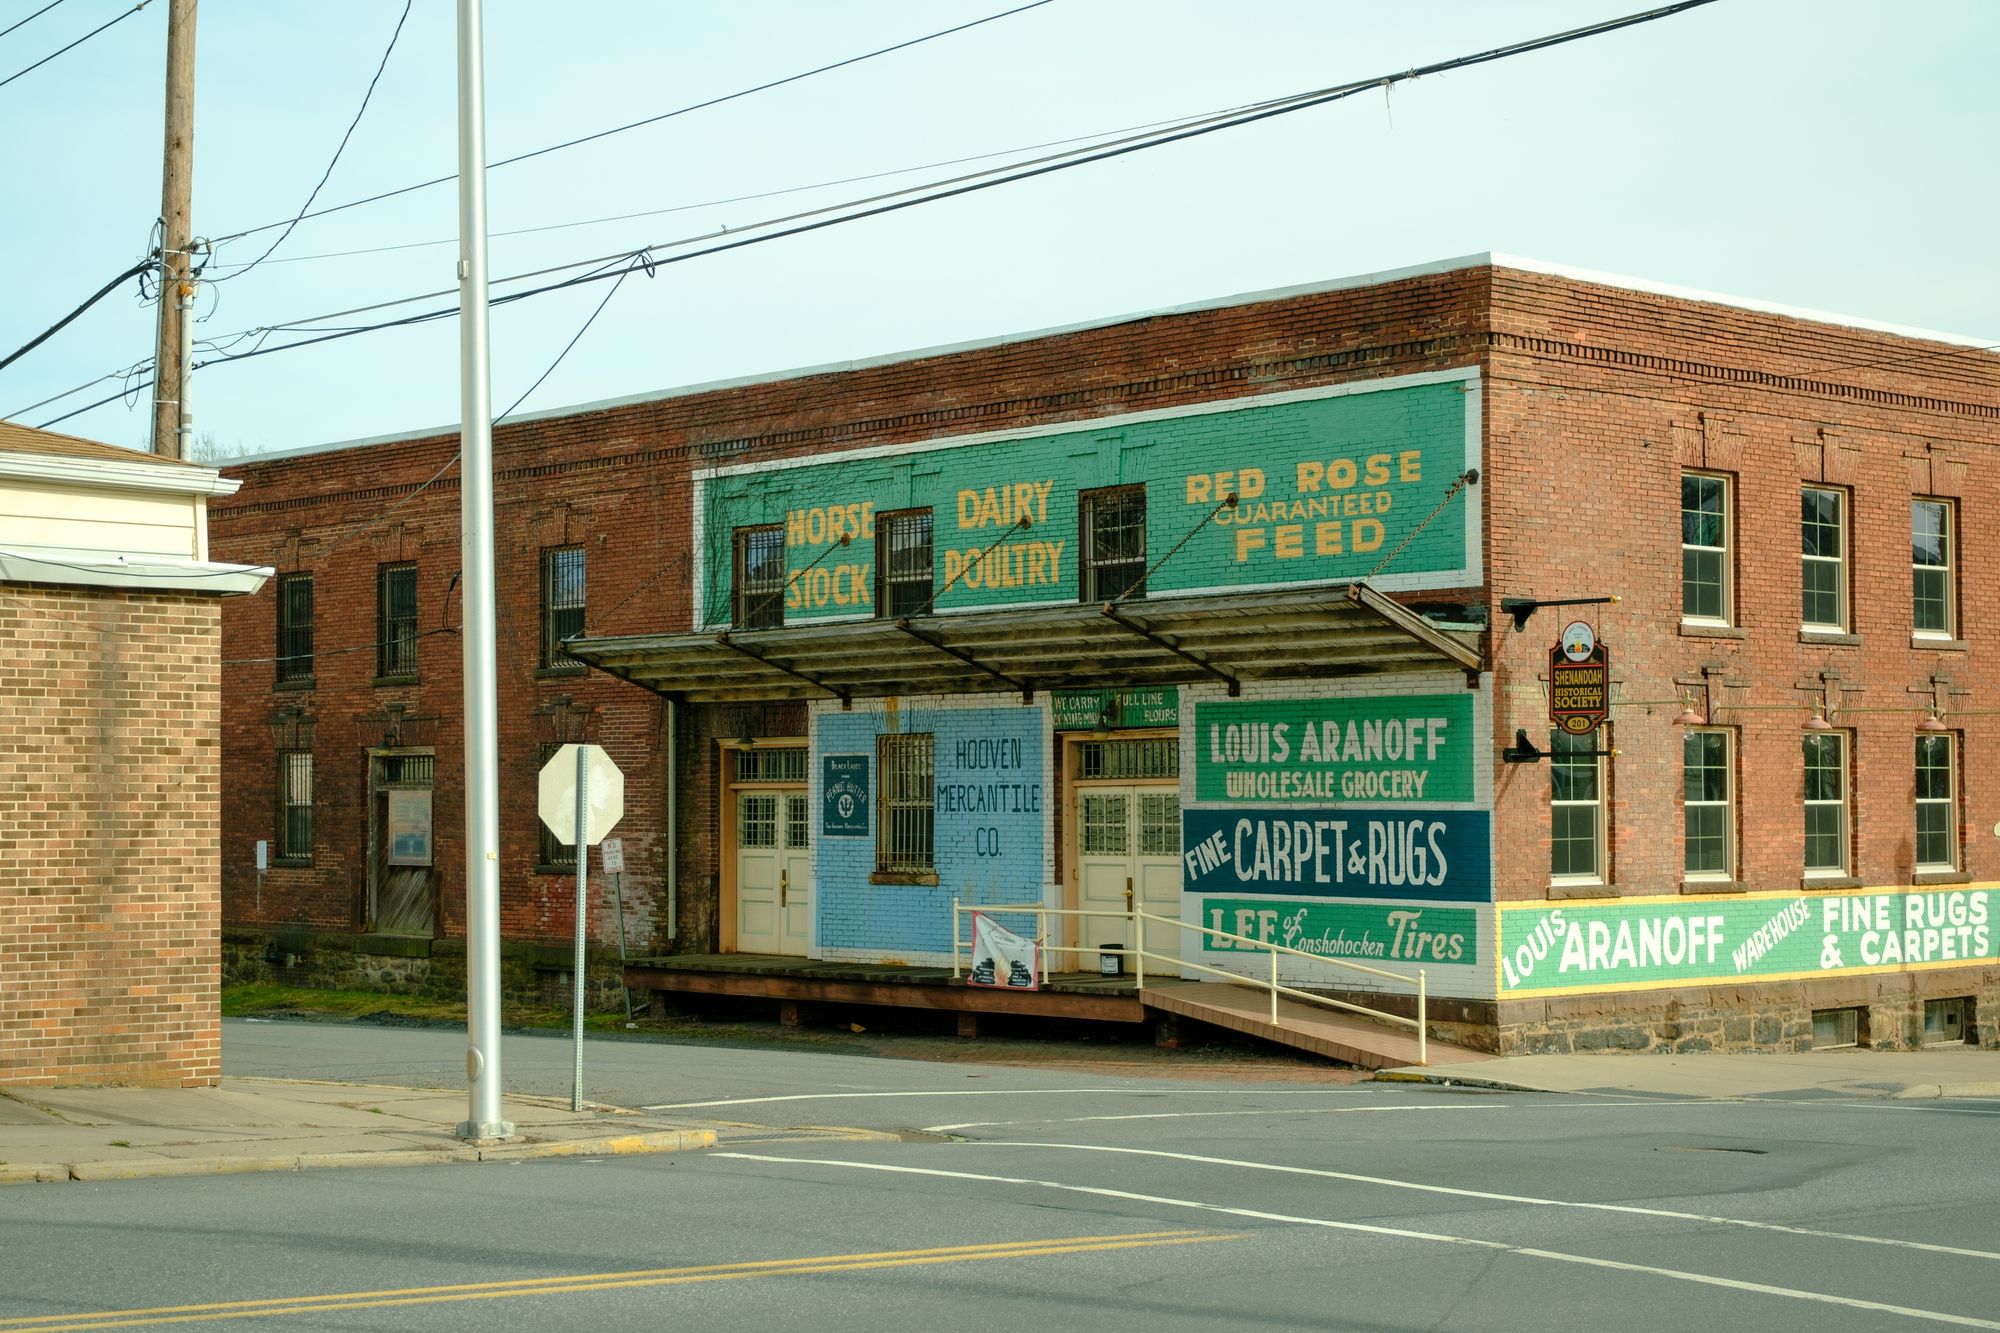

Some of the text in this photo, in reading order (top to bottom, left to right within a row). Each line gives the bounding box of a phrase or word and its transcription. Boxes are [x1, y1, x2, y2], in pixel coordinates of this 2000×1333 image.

[1186, 450, 1422, 504] RED ROSE
[787, 502, 876, 547] HORSE
[957, 479, 1054, 530] DAIRY
[1213, 491, 1393, 525] GUARANTEED
[1235, 518, 1386, 562] FEED
[787, 564, 871, 610] STOCK
[944, 541, 1065, 592] POULTRY
[1554, 669, 1602, 685] SHENANDOAH
[1554, 687, 1603, 697] HISTORICAL
[1069, 695, 1100, 710] CARRY
[1115, 694, 1139, 706] FULL
[1142, 692, 1163, 705] LINE
[1144, 708, 1177, 722] FLOURS
[1554, 696, 1602, 708] SOCIETY
[1210, 717, 1448, 764] LOUIS ARANOFF
[1571, 719, 1586, 728] 201
[956, 737, 1022, 770] HOOVEN
[936, 784, 1040, 813] MERCANTILE
[1226, 769, 1429, 799] WHOLESALE GROCERY
[976, 827, 1003, 857] CO.
[1184, 818, 1448, 887] FINE CARPET & RUGS
[1823, 891, 1989, 933] FINE RUGS
[1210, 908, 1465, 960] LEE of Conshohocken Tires
[1502, 909, 1725, 988] LOUIS ARANOFF
[1731, 896, 1812, 974] WAREHOUSE
[1820, 924, 1990, 970] & CARPETS
